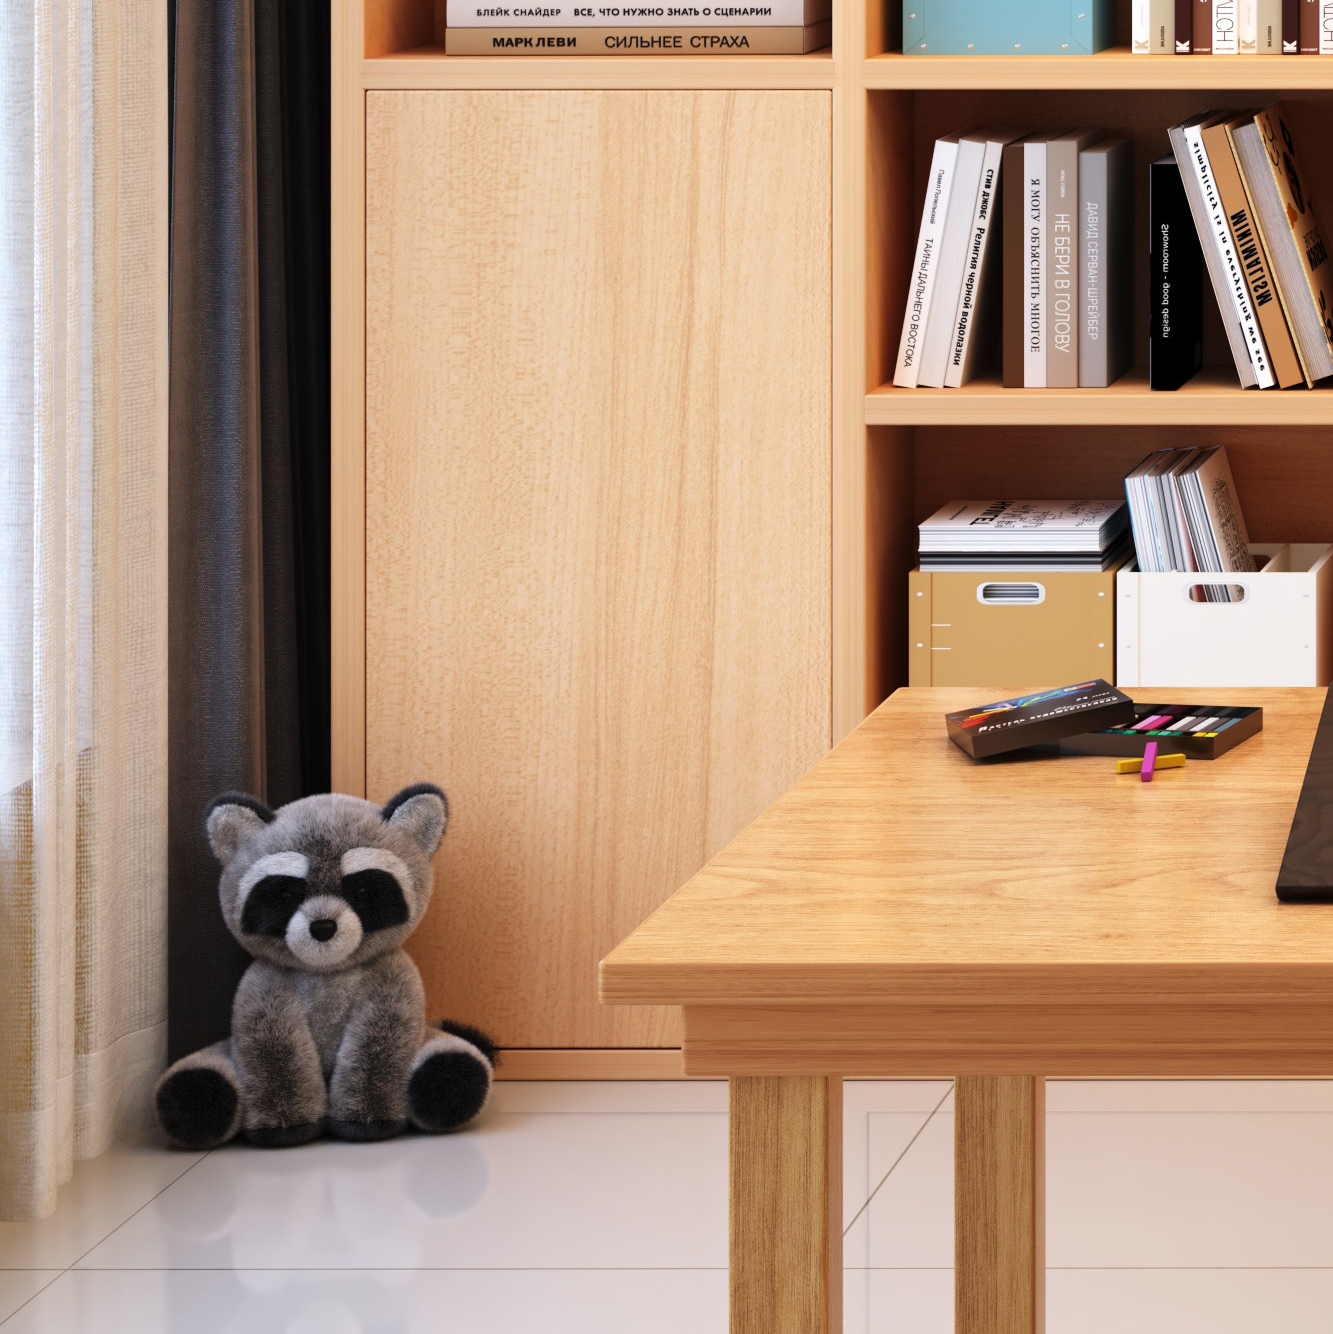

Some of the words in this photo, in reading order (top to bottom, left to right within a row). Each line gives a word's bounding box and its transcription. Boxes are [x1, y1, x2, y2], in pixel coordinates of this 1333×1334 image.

[604, 36, 683, 48] СИЛЬНЕЕ
[689, 35, 750, 48] СТРАХА
[1055, 213, 1070, 232] НЕ
[1054, 237, 1070, 275] БЕРИ
[1055, 280, 1070, 288] В
[1054, 293, 1070, 353] ГОЛОВУ
